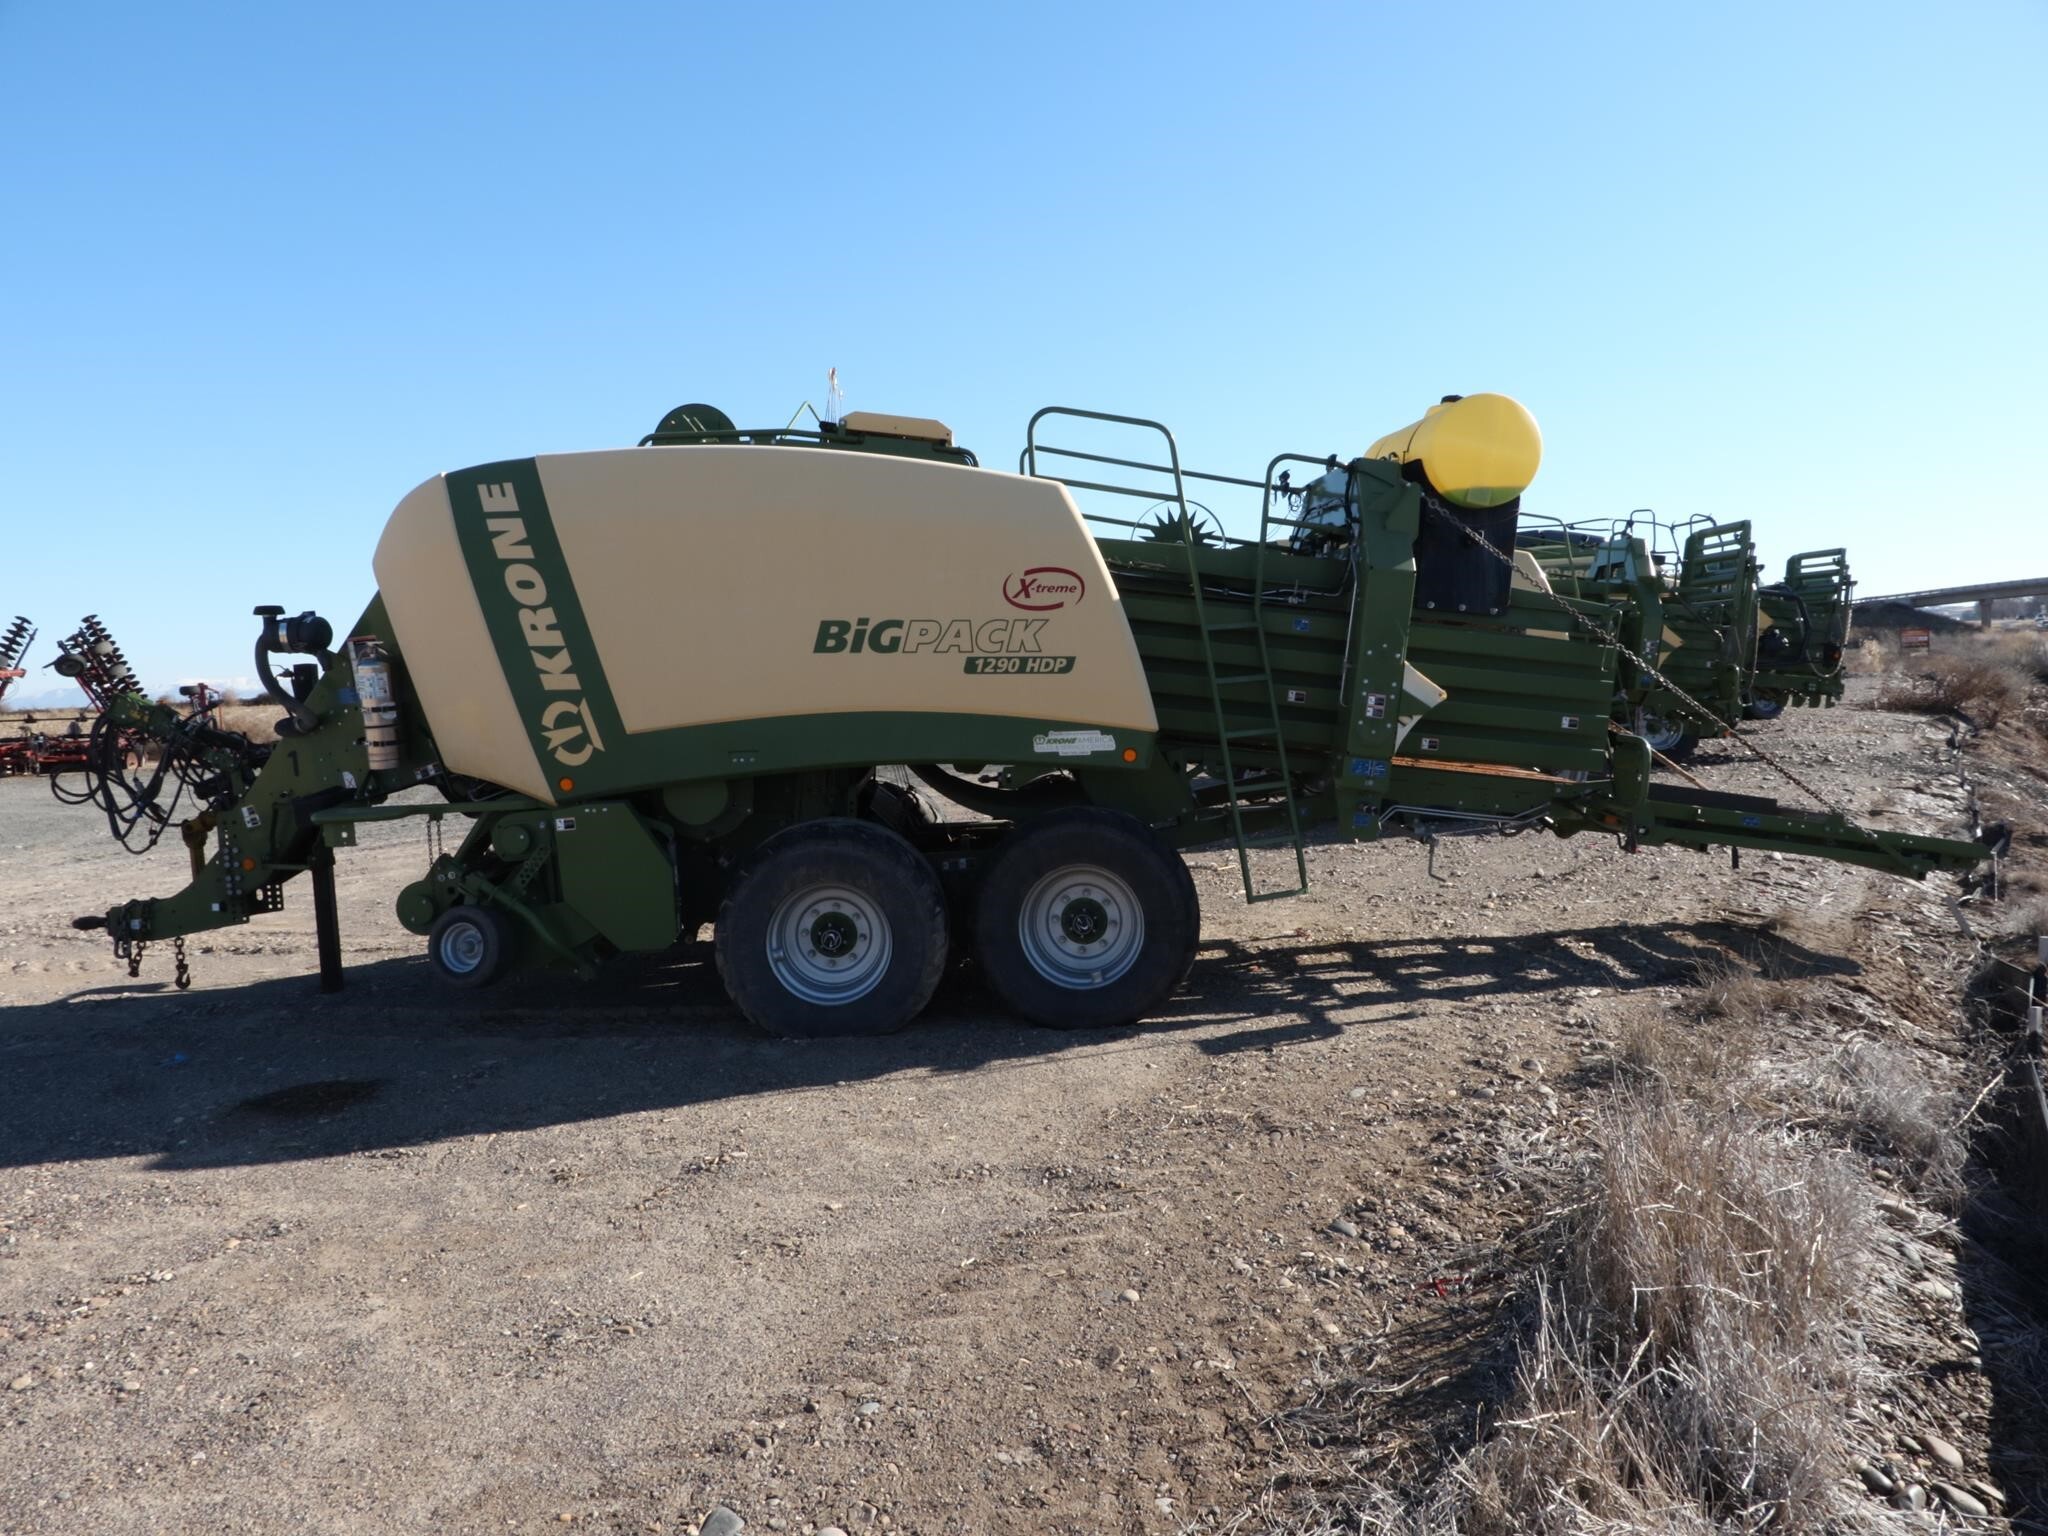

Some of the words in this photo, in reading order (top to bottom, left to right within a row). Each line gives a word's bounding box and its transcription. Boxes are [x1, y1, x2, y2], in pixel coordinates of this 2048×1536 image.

[477, 481, 582, 690] KRONE
[1012, 578, 1078, 599] X-treme
[974, 658, 1020, 673] 1290
[1025, 658, 1067, 673] HDP
